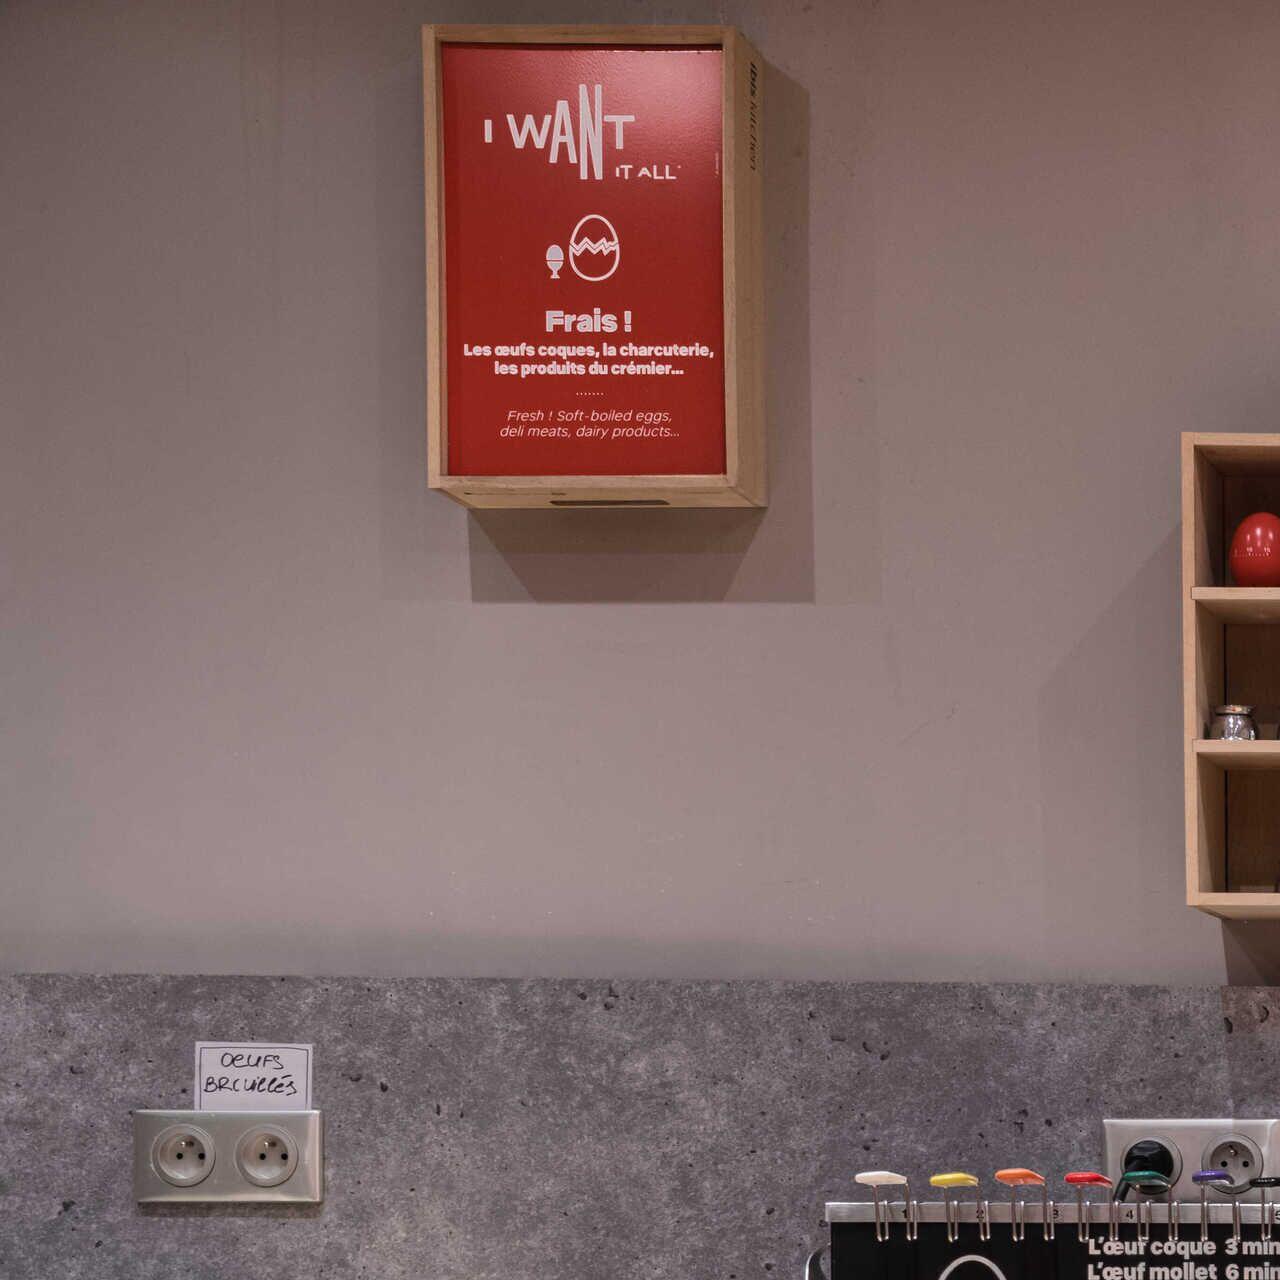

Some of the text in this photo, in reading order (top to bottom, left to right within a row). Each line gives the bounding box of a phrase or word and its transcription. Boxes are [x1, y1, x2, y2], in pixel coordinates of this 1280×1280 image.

[484, 83, 635, 180] I WANT
[615, 164, 677, 180] IT ALL
[545, 308, 632, 333] Frais !
[463, 342, 714, 360] Les œufs coques, la charcuterie,
[494, 361, 518, 375] les
[520, 361, 586, 379] produits
[587, 361, 609, 375] du
[507, 410, 545, 422] Fresh
[556, 410, 633, 422] Soft-boiled
[635, 411, 672, 425] eggs,
[499, 425, 524, 438] deli
[527, 427, 571, 439] meats,
[575, 425, 609, 440] dairy
[1087, 1236, 1146, 1256] L'œuf
[1150, 1239, 1217, 1260] coque
[1225, 1237, 1239, 1256] 3
[1087, 1262, 1146, 1280] L'œuf
[1149, 1262, 1218, 1280] mollet
[1225, 1264, 1240, 1280] 6
